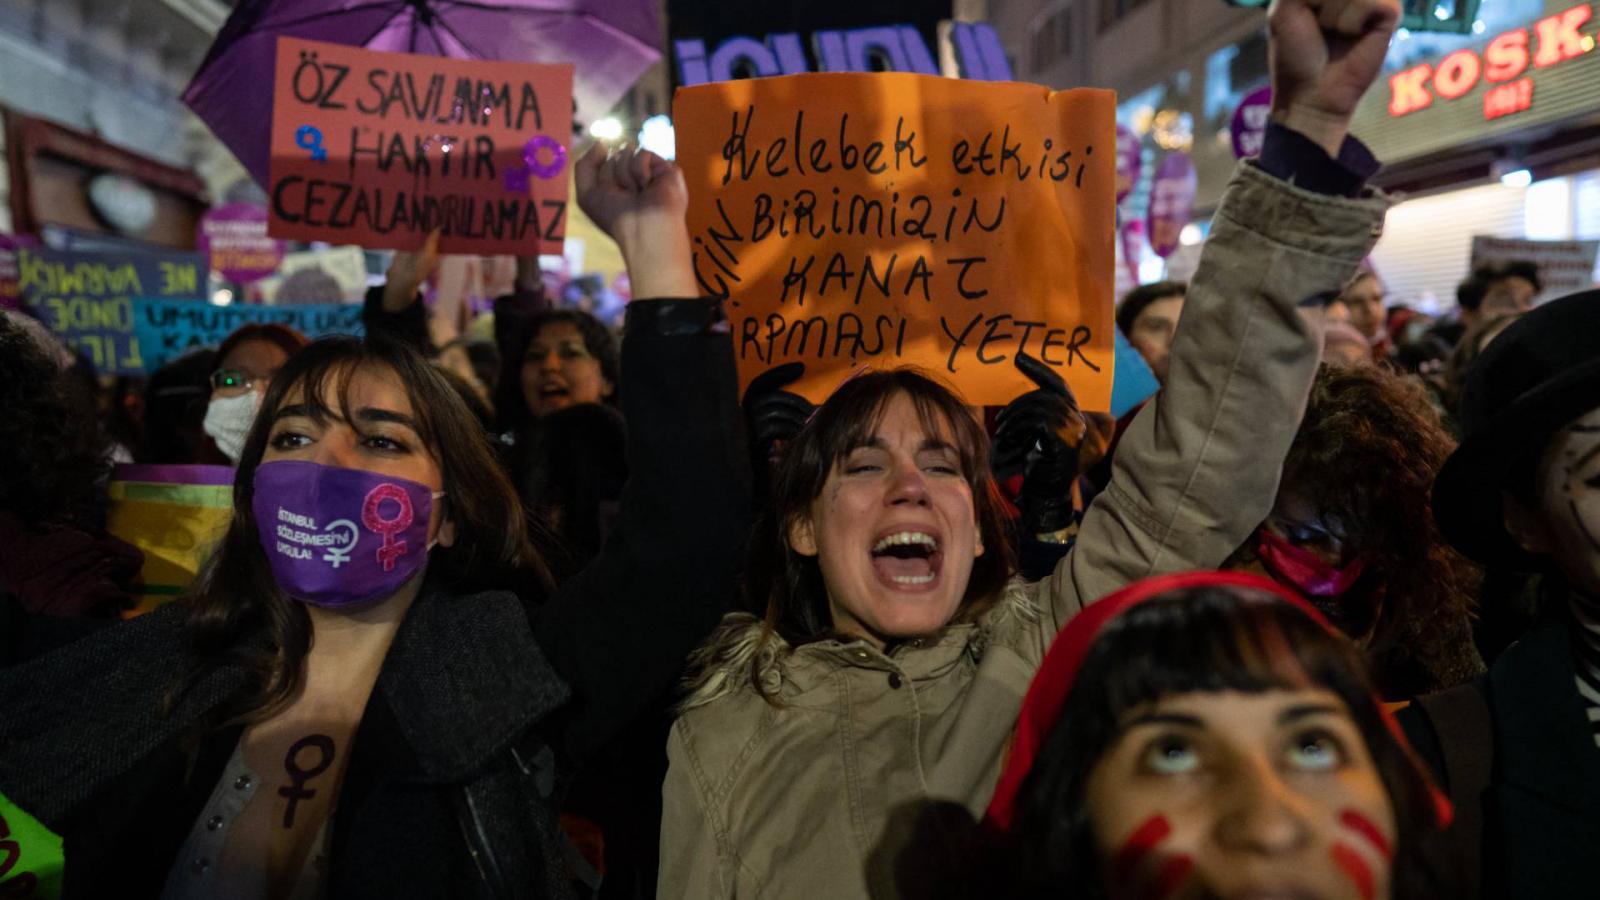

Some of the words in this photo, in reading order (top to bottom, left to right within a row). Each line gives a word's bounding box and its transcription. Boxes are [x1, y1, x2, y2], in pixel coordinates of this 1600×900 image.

[292, 51, 349, 110] ÖZ
[356, 69, 543, 131] SAVUNMA
[1388, 3, 1600, 117] KOSK
[350, 126, 497, 182] HAKTIR
[722, 105, 927, 186] Kelebek
[952, 125, 1093, 188] etkisi
[782, 254, 987, 306] KANAT
[940, 313, 1099, 373] YETER
